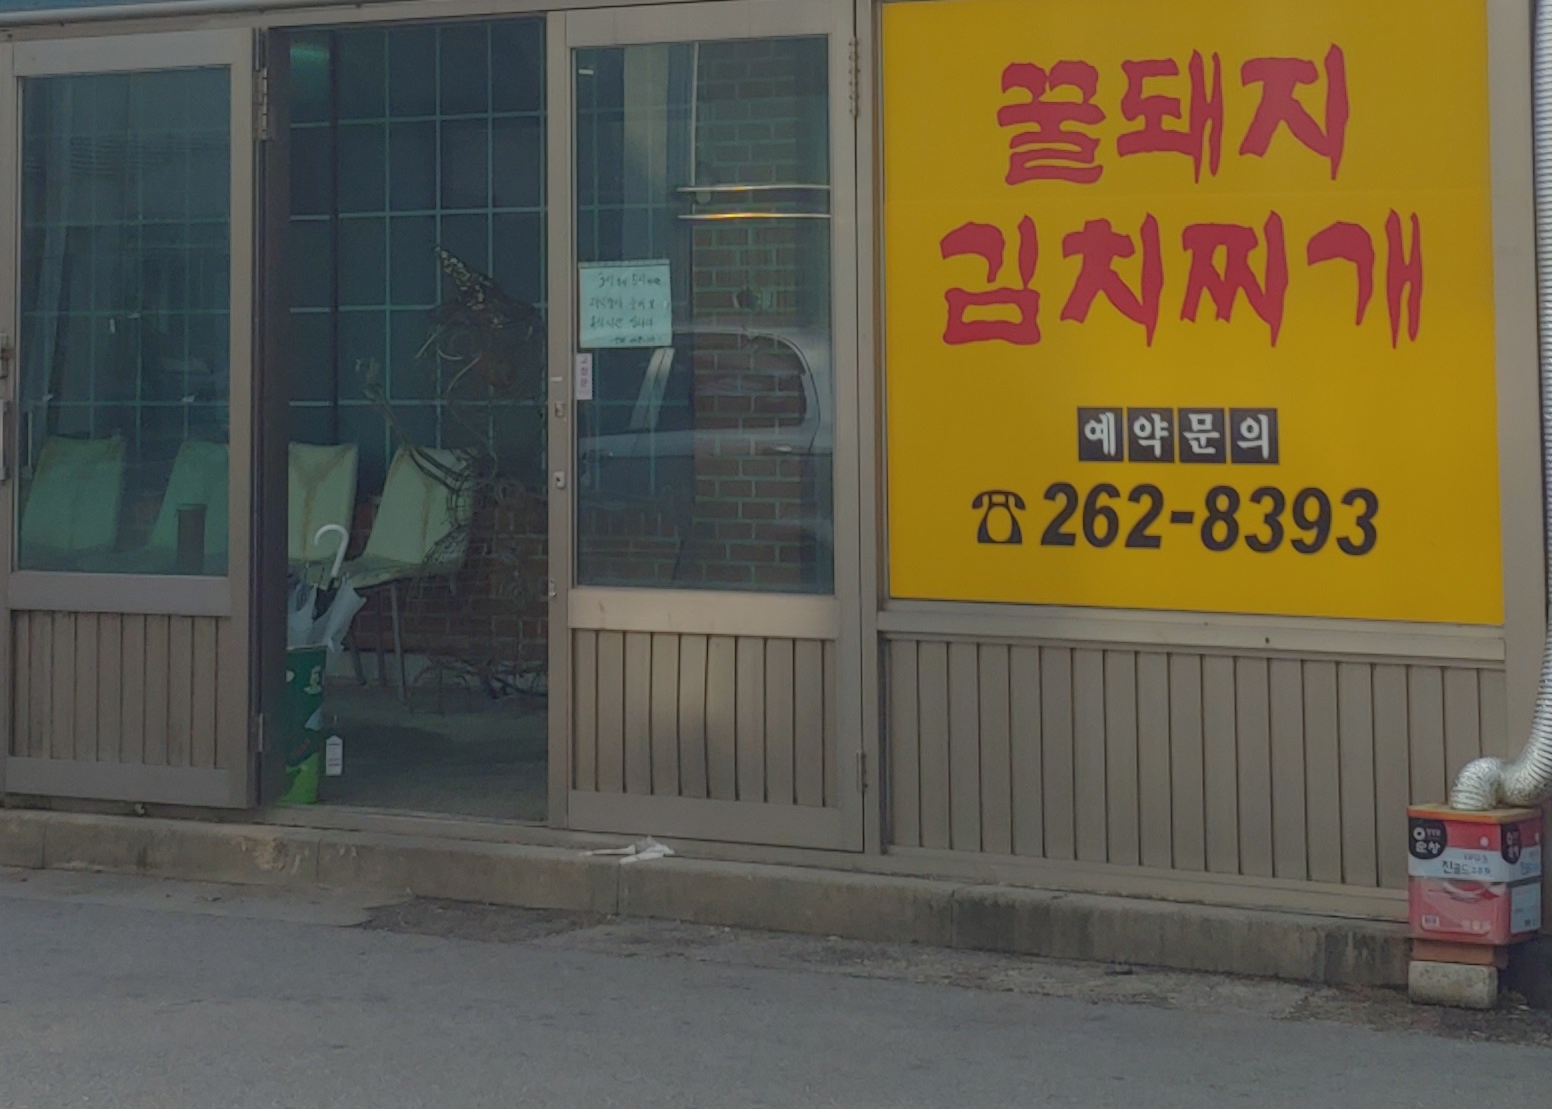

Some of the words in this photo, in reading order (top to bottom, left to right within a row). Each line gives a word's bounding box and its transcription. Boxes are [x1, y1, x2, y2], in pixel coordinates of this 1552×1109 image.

[997, 42, 1350, 186] 꿀돼지
[940, 207, 1423, 350] 김치찌개
[1081, 410, 1273, 462] 예약문의
[1040, 482, 1380, 556] 262-8393
